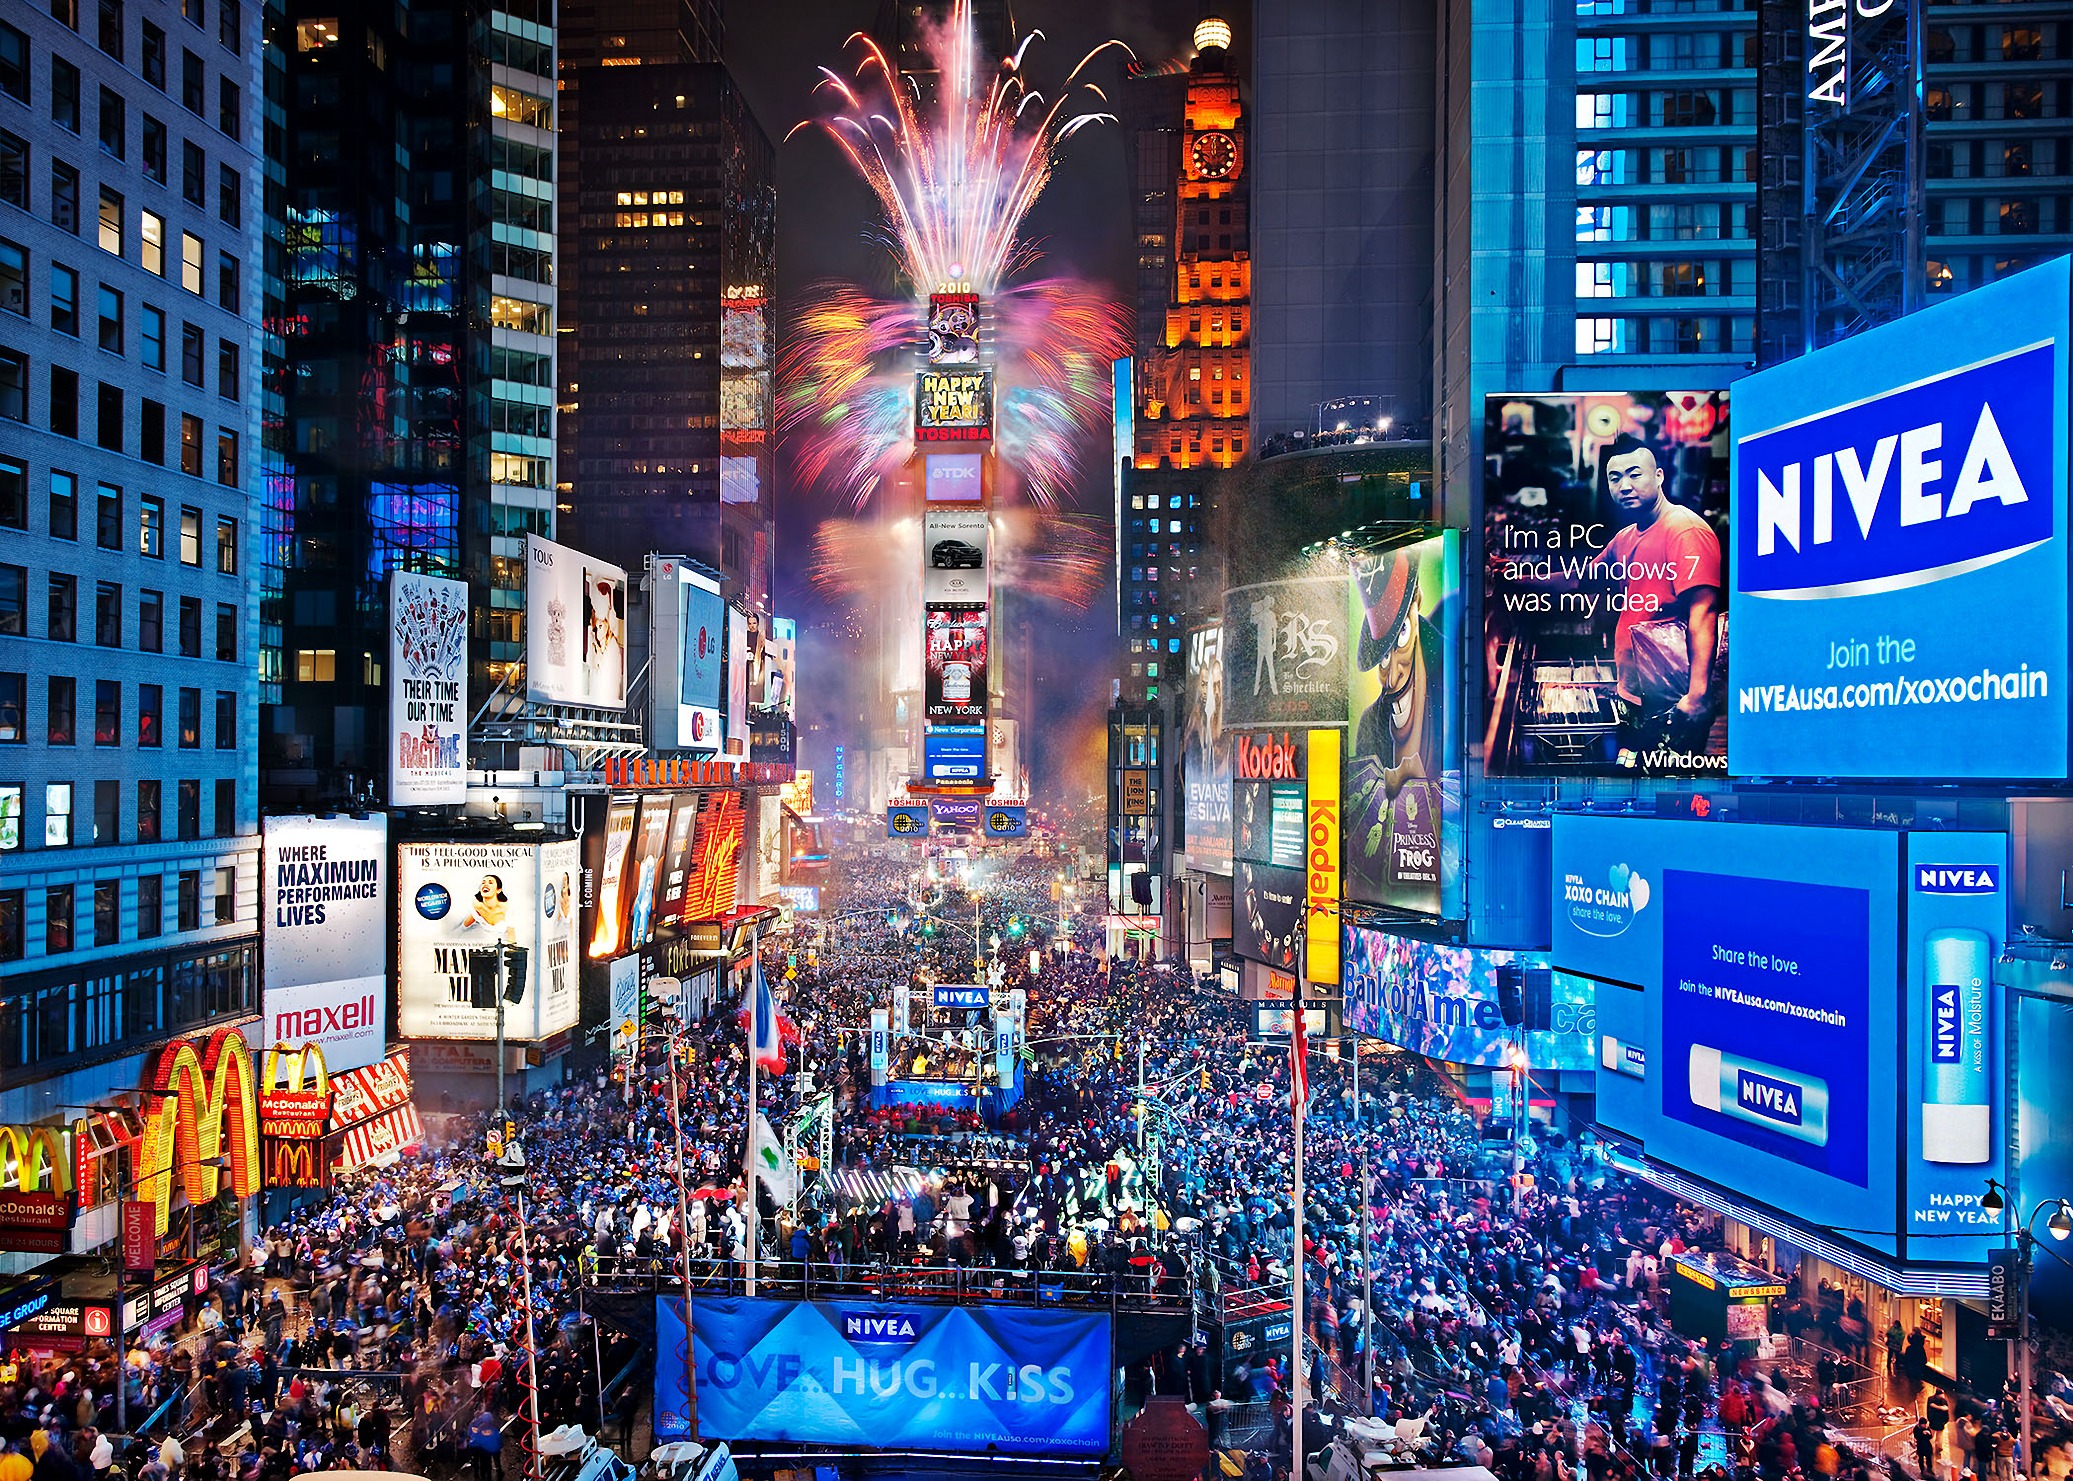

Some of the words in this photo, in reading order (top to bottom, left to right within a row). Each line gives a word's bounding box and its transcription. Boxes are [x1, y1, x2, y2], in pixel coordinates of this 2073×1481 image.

[939, 282, 970, 293] 2010
[931, 295, 979, 303] TOSHIBA
[924, 377, 984, 392] HAPPY
[934, 392, 973, 405] NEW
[929, 405, 978, 420] YEAR!
[915, 428, 990, 441] TOSHIBA
[945, 468, 975, 479] TDK
[1757, 401, 2029, 556] NIVEA
[1504, 524, 1537, 548] I'm
[1547, 530, 1561, 548] a
[1571, 524, 1604, 549] PC
[533, 548, 554, 567] TOUS
[1504, 556, 1551, 580] and
[1560, 556, 1676, 580] Windows
[1687, 556, 1700, 581] 7
[1504, 593, 1551, 612] was
[1560, 593, 1599, 619] my
[1606, 589, 1663, 612] idea.
[708, 636, 715, 654] LG
[930, 640, 982, 652] HAPPY
[1827, 640, 1869, 670] Join
[1877, 635, 1916, 664] the
[930, 652, 952, 661] NEW
[403, 679, 431, 699] THEIR
[435, 681, 459, 701] TIME
[1282, 682, 1331, 695] Sheckler
[1739, 663, 2048, 714] NIVEAusa.com/xoxochain
[408, 701, 426, 721] OUR
[429, 703, 454, 722] TIME
[929, 706, 955, 715] NEW
[956, 706, 982, 715] YORK
[400, 732, 460, 768] RAGTIME
[1238, 733, 1297, 779] Kodak
[1642, 750, 1728, 769] Windows
[1126, 786, 1144, 797] LION
[1191, 783, 1228, 801] EVANS
[933, 805, 978, 815] YAHOO!
[1126, 797, 1144, 808] KING
[620, 813, 631, 831] OPEN
[1197, 803, 1231, 823] SILVA
[434, 847, 488, 857] FEEL-GOOD
[491, 847, 533, 857] MUSICAL
[1393, 833, 1436, 853] PRINCESS
[278, 845, 327, 862] WHERE
[421, 858, 430, 867] IS
[434, 858, 441, 867] A
[1310, 800, 1336, 918] Kodak
[1398, 849, 1435, 870] FROG
[277, 859, 377, 887] MAXIMUM
[1921, 869, 1994, 887] NIVEA
[585, 868, 593, 898] COMING
[277, 883, 377, 905] PERFORMANCE
[585, 899, 593, 907] IS
[1565, 885, 1592, 904] XOXO
[1595, 889, 1628, 908] CHAIN
[277, 904, 326, 928] LIVES
[1573, 905, 1591, 919] share
[1593, 908, 1604, 921] the
[1606, 911, 1623, 924] love.
[1712, 944, 1744, 965] Share
[1748, 951, 1768, 969] the
[1772, 955, 1801, 976] love.
[939, 991, 985, 1004] NIVEA
[1343, 961, 1389, 1009] Bank
[1391, 982, 1416, 1017] of
[1413, 979, 1595, 1034] Ameca
[1679, 979, 1696, 993] Join
[1698, 983, 1713, 997] the
[1715, 986, 1846, 1027] NIVEAusa.com/xoxochain
[1968, 978, 1982, 1035] Moisture
[276, 994, 375, 1041] maxell
[1937, 989, 1955, 1057] NIVEA
[304, 1029, 374, 1046] www.maxell.com
[1974, 1038, 1981, 1049] OF
[262, 1100, 327, 1110] McDonald's
[1743, 1078, 1798, 1117] NIVEA
[1930, 1193, 1983, 1207] HAPPY
[1915, 1210, 1950, 1222] NEW
[29, 1240, 59, 1248] HOURS
[129, 1206, 141, 1266] WELCOME
[154, 1285, 169, 1298] TIMES
[1732, 1287, 1782, 1296] NEWSSTAND
[1992, 1265, 2005, 1320] EKAABO
[14, 1295, 48, 1319] GROUP
[51, 1308, 79, 1316] SQUARE
[162, 1297, 181, 1312] CENTER
[39, 1323, 66, 1332] CENTER
[848, 1319, 915, 1337] NIVEA
[1266, 1326, 1290, 1338] NIVEA
[933, 1430, 952, 1440] Join
[956, 1431, 971, 1440] the
